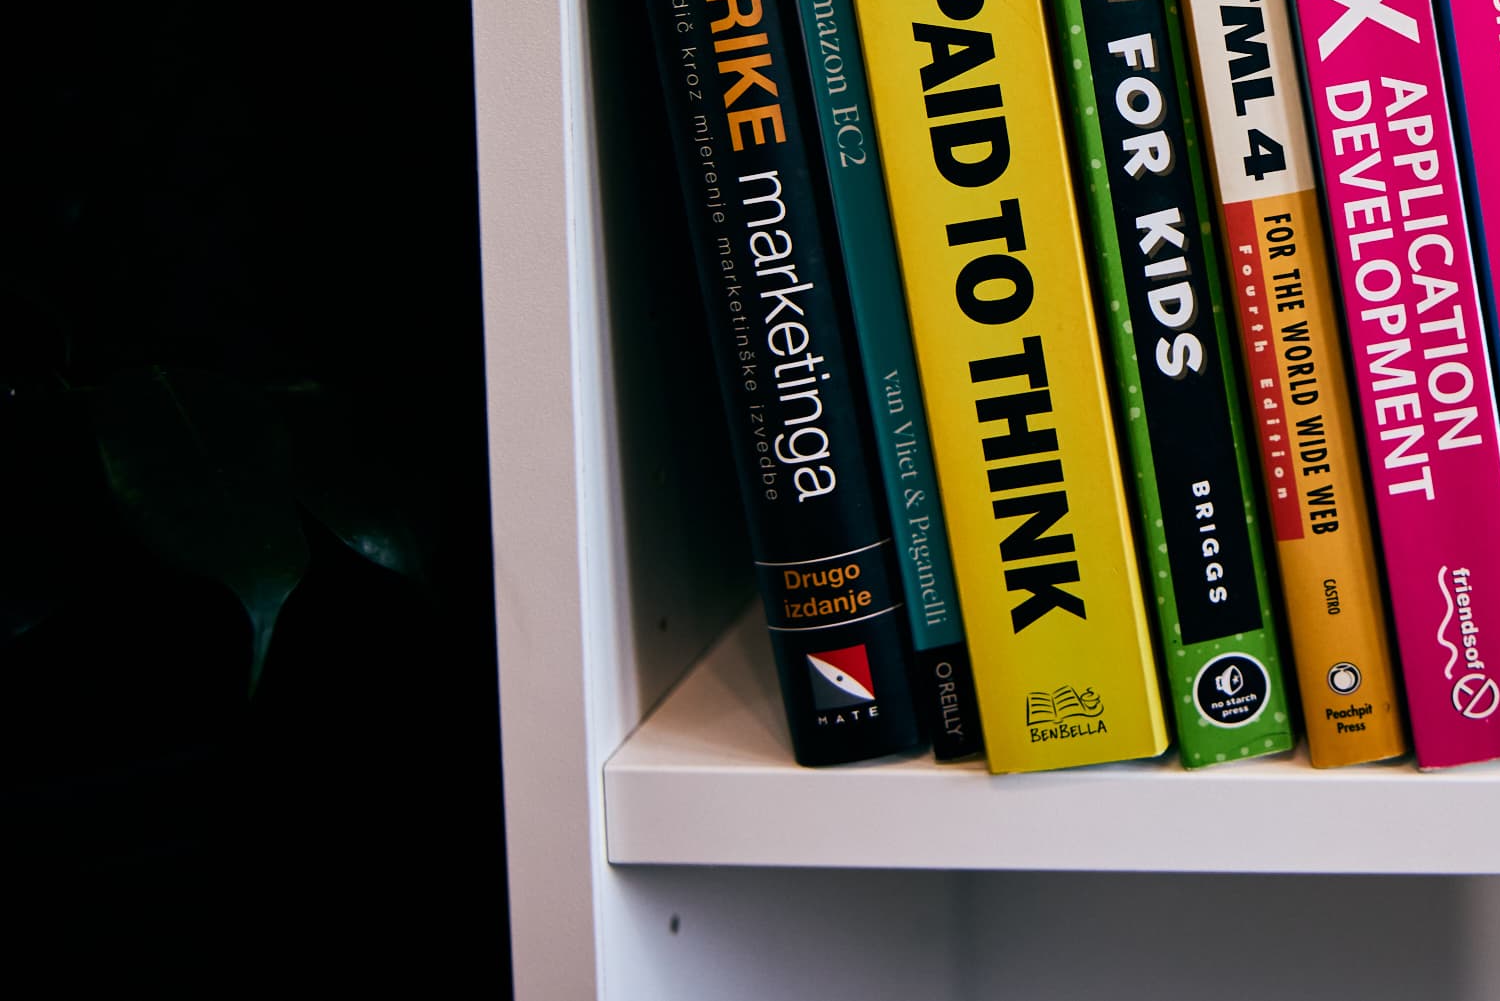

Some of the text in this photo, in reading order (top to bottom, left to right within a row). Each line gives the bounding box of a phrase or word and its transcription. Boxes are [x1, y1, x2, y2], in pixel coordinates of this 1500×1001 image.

[833, 104, 867, 168] EC2
[1243, 128, 1287, 180] 4
[945, 198, 1034, 325] TO
[1107, 32, 1203, 378] FOR KIDS
[1380, 76, 1482, 451] APPLICATION
[682, 47, 702, 100] kroz
[693, 114, 726, 223] mjerenje
[717, 236, 758, 392] marketinške
[749, 403, 778, 501] izvedbe
[738, 170, 837, 502] marketinga
[1325, 79, 1435, 501] DEVELOPMENT
[1239, 244, 1288, 499] Fourth Edition
[1264, 212, 1339, 536] FOR THE WORLD WIDE WEB
[884, 369, 947, 626] van Vliet & Paganelli
[969, 335, 1087, 634] THINK
[1191, 479, 1227, 603] BRIGGS
[784, 563, 860, 591] Drugo
[784, 587, 872, 619] izdanje
[1323, 578, 1340, 615] CASTRO
[818, 706, 879, 726] MATE
[1211, 692, 1257, 710] no starch
[1222, 703, 1249, 718] press
[1326, 703, 1373, 721] Peachpit
[1336, 720, 1366, 734] Press
